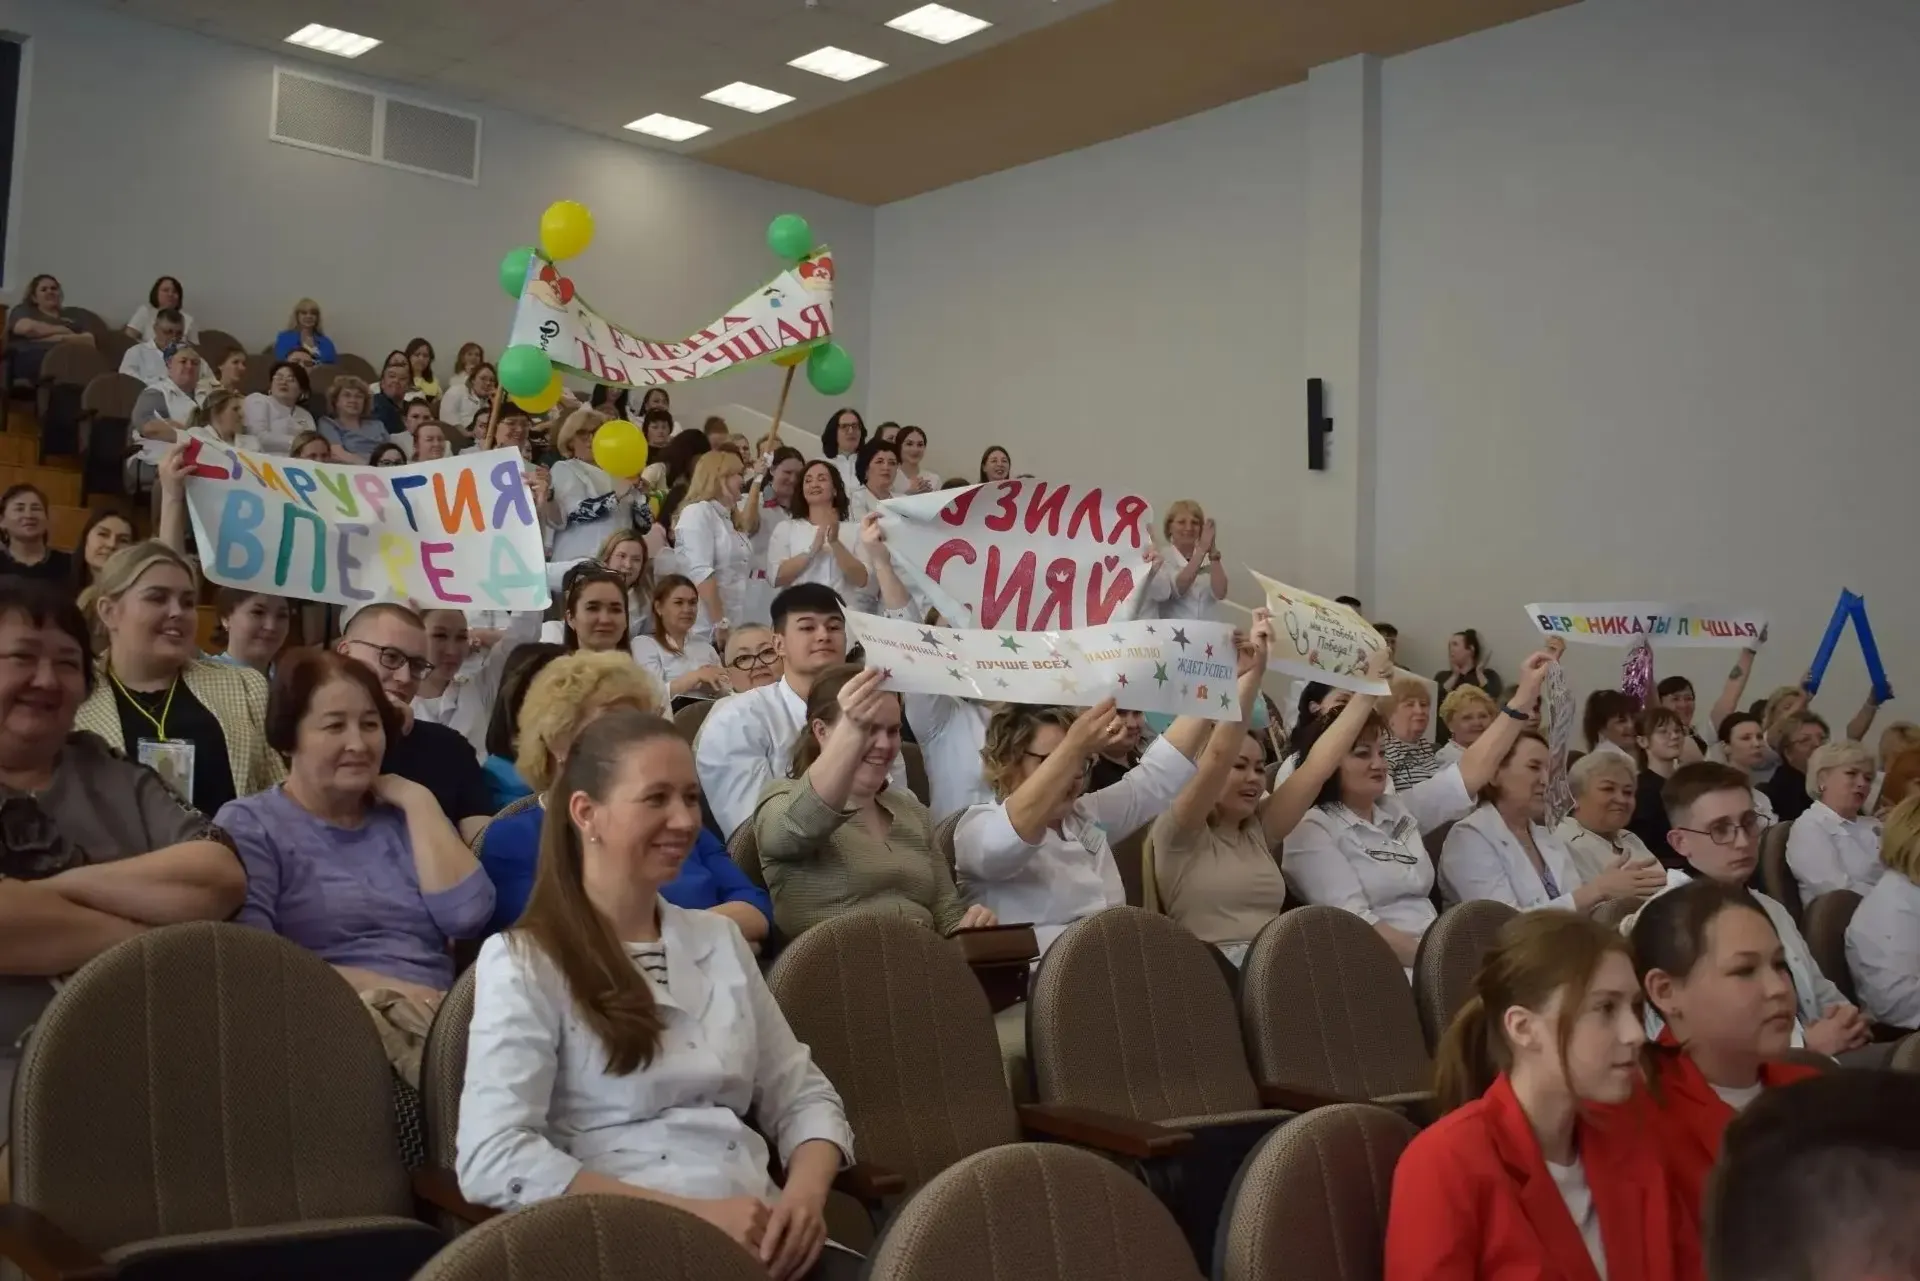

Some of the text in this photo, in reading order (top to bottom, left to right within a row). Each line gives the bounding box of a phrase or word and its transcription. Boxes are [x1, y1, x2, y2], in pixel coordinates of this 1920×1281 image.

[574, 336, 634, 386] ТЫ
[214, 488, 548, 607] ВПЕРЕД
[1536, 614, 1645, 634] ВЕРОНИКА
[1646, 615, 1671, 635] ТЫ
[975, 659, 1073, 670] ЛУЧШЕ ВСЕХ
